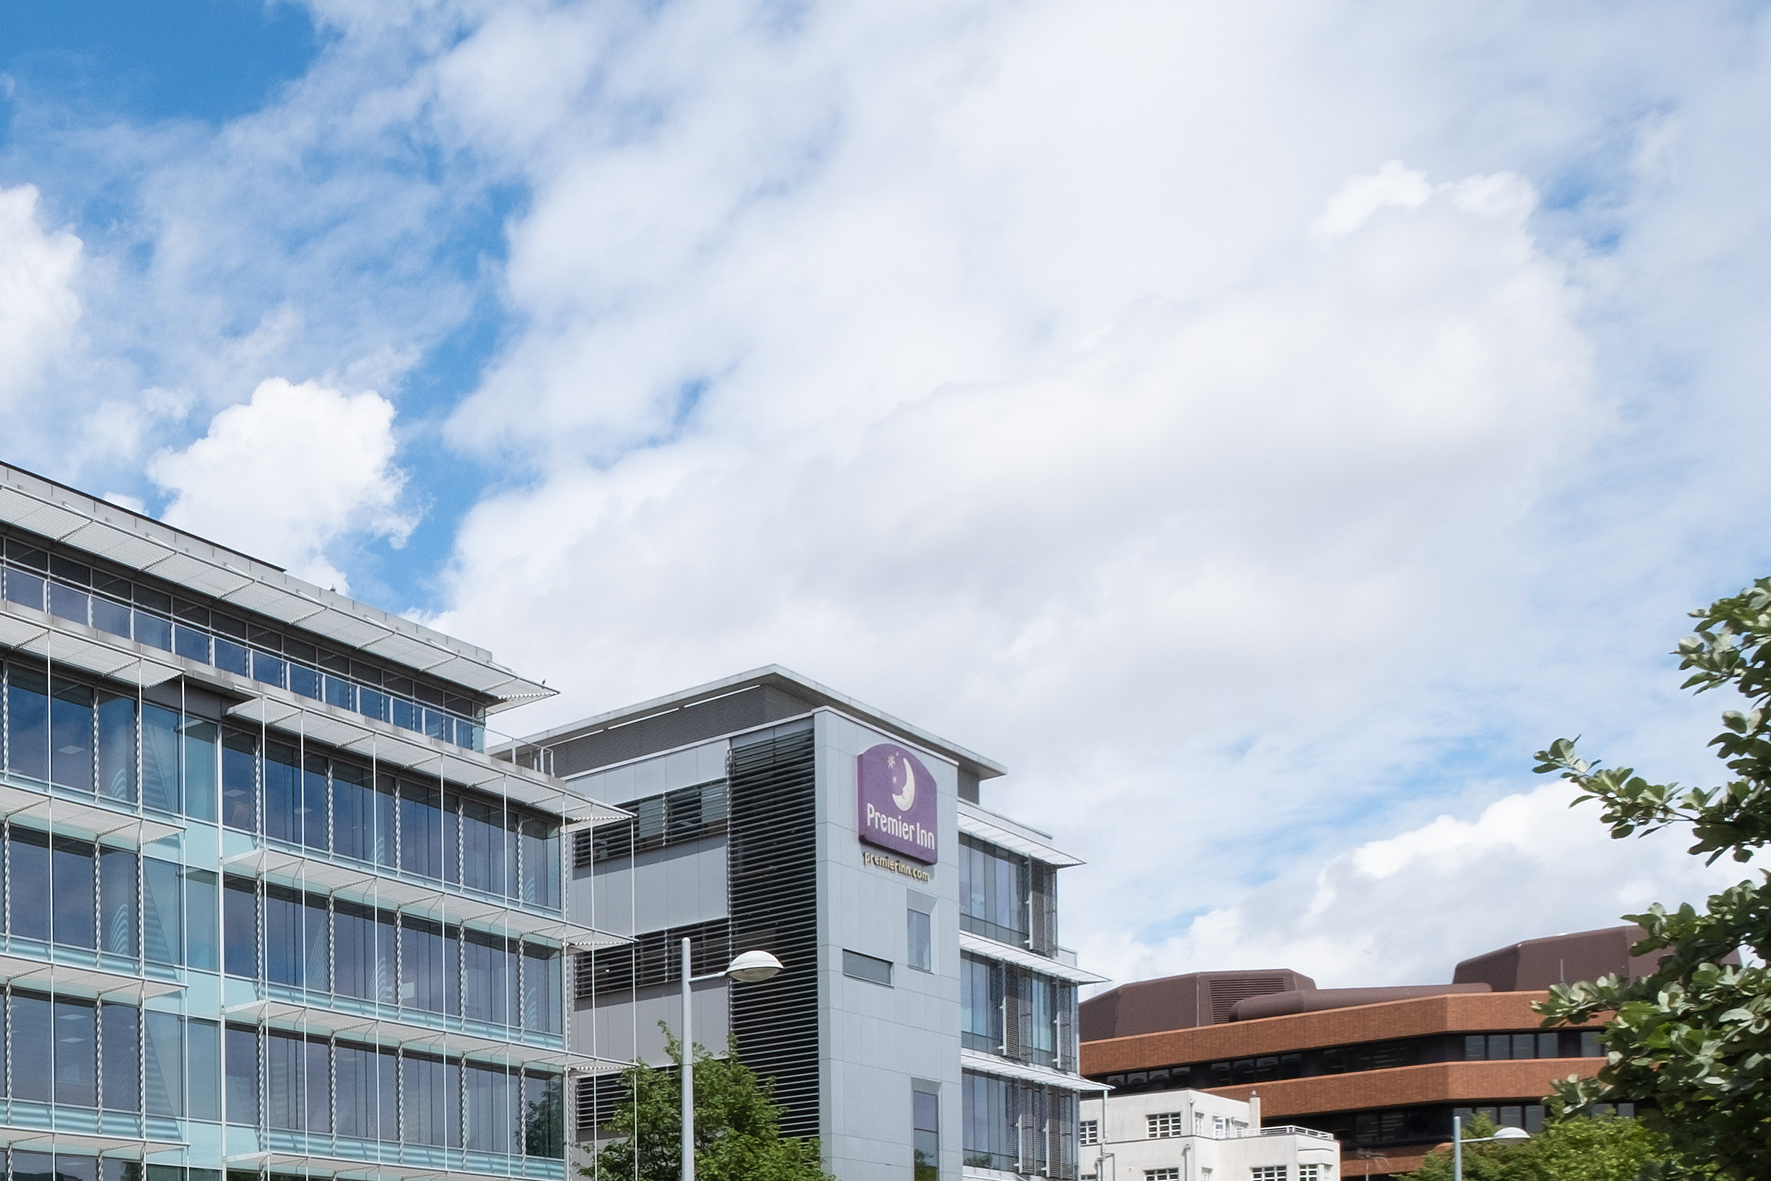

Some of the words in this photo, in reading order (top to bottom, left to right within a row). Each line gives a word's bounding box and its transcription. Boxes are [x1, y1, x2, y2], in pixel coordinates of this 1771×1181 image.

[866, 802, 915, 842] Premier
[916, 822, 935, 851] Inn
[863, 852, 929, 882] premierinn.com
